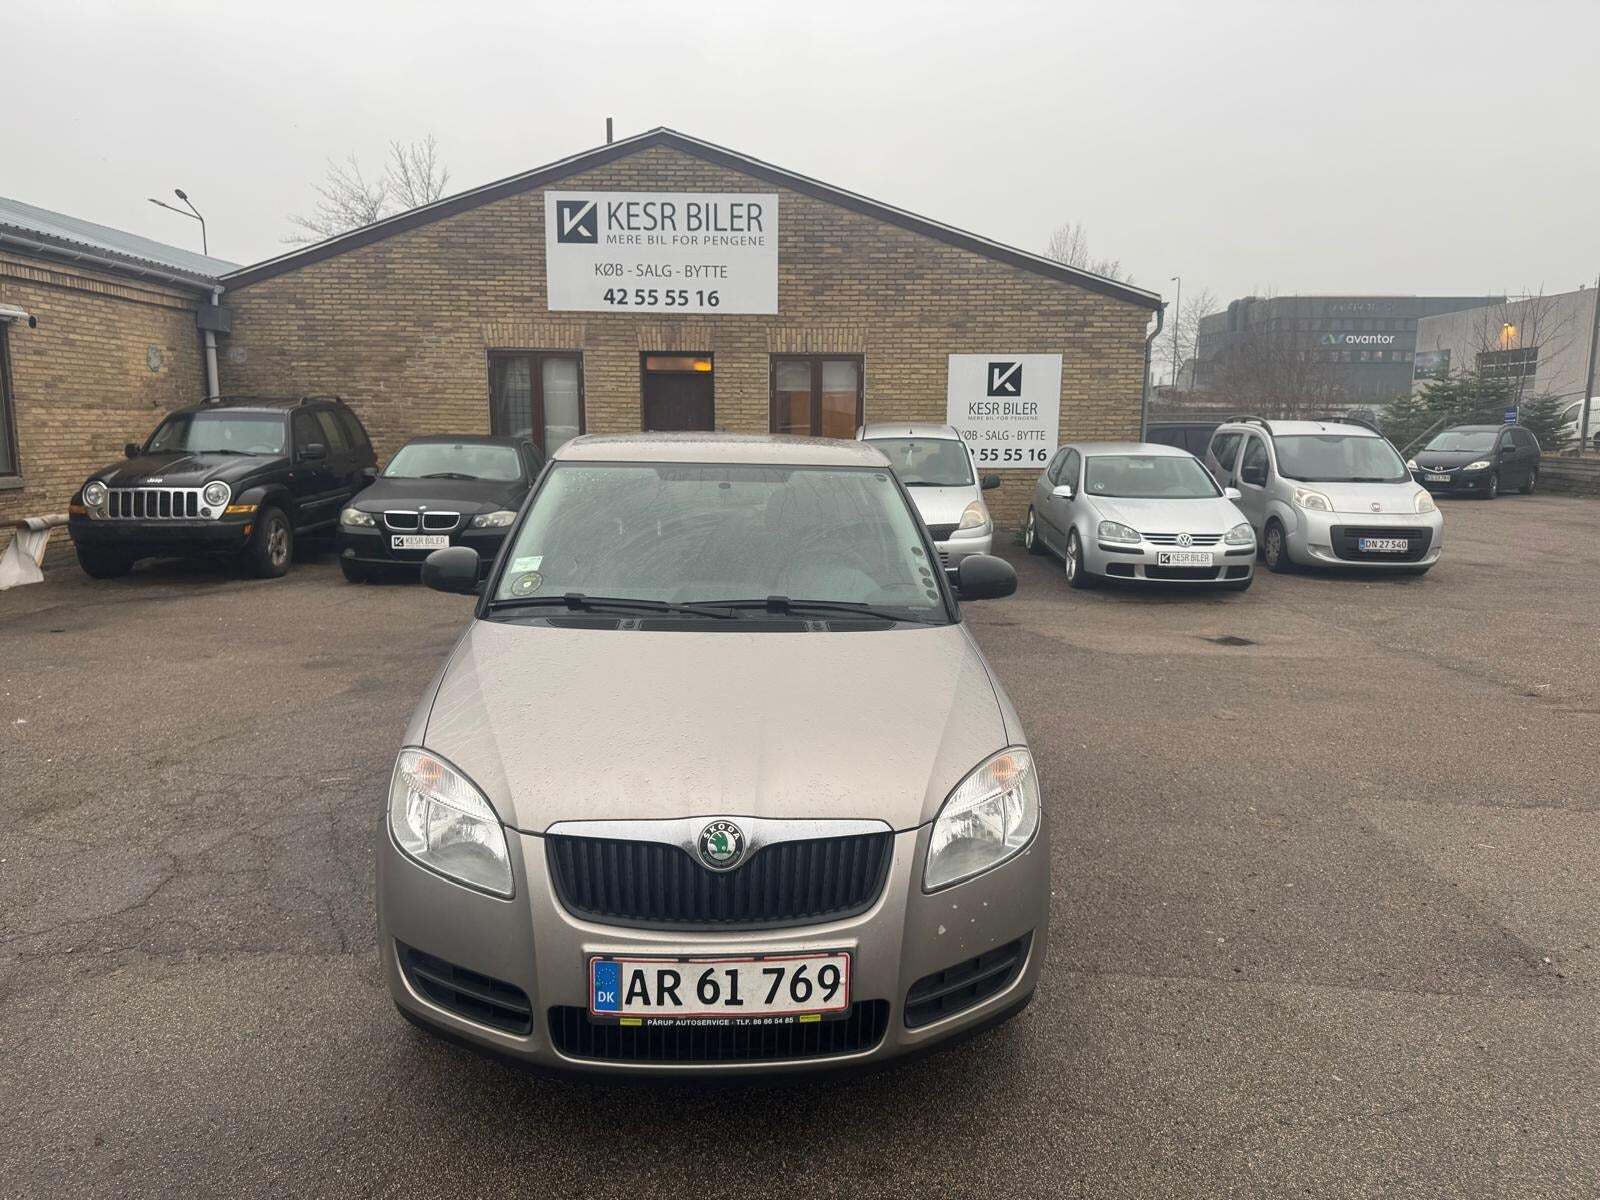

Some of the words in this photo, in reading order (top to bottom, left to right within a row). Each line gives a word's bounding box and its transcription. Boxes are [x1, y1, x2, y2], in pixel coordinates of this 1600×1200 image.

[607, 201, 677, 231] KESR
[687, 202, 763, 232] BILER
[606, 234, 642, 245] MERE
[648, 234, 667, 245] BIL
[673, 235, 698, 245] FOR
[704, 235, 765, 246] PENGENE
[594, 263, 624, 276] KØB
[636, 264, 672, 278] SALG
[685, 265, 728, 278] BYTTE
[603, 288, 628, 305] 42
[634, 289, 658, 306] 55
[665, 289, 689, 306] 55
[696, 290, 720, 307] 16
[1345, 334, 1395, 344] avantor
[969, 402, 1000, 415] KESR
[1003, 402, 1038, 415] BILER
[985, 430, 1009, 441] SALG
[1017, 430, 1046, 441] BYTTE
[979, 448, 999, 461] 55
[1003, 448, 1023, 461] 55
[1028, 448, 1047, 461] 16
[1365, 540, 1378, 548] DN
[1379, 540, 1390, 549] 27
[624, 968, 683, 1006] AR
[696, 967, 744, 1006] 61
[762, 964, 841, 1005] 769
[598, 991, 615, 1003] DK
